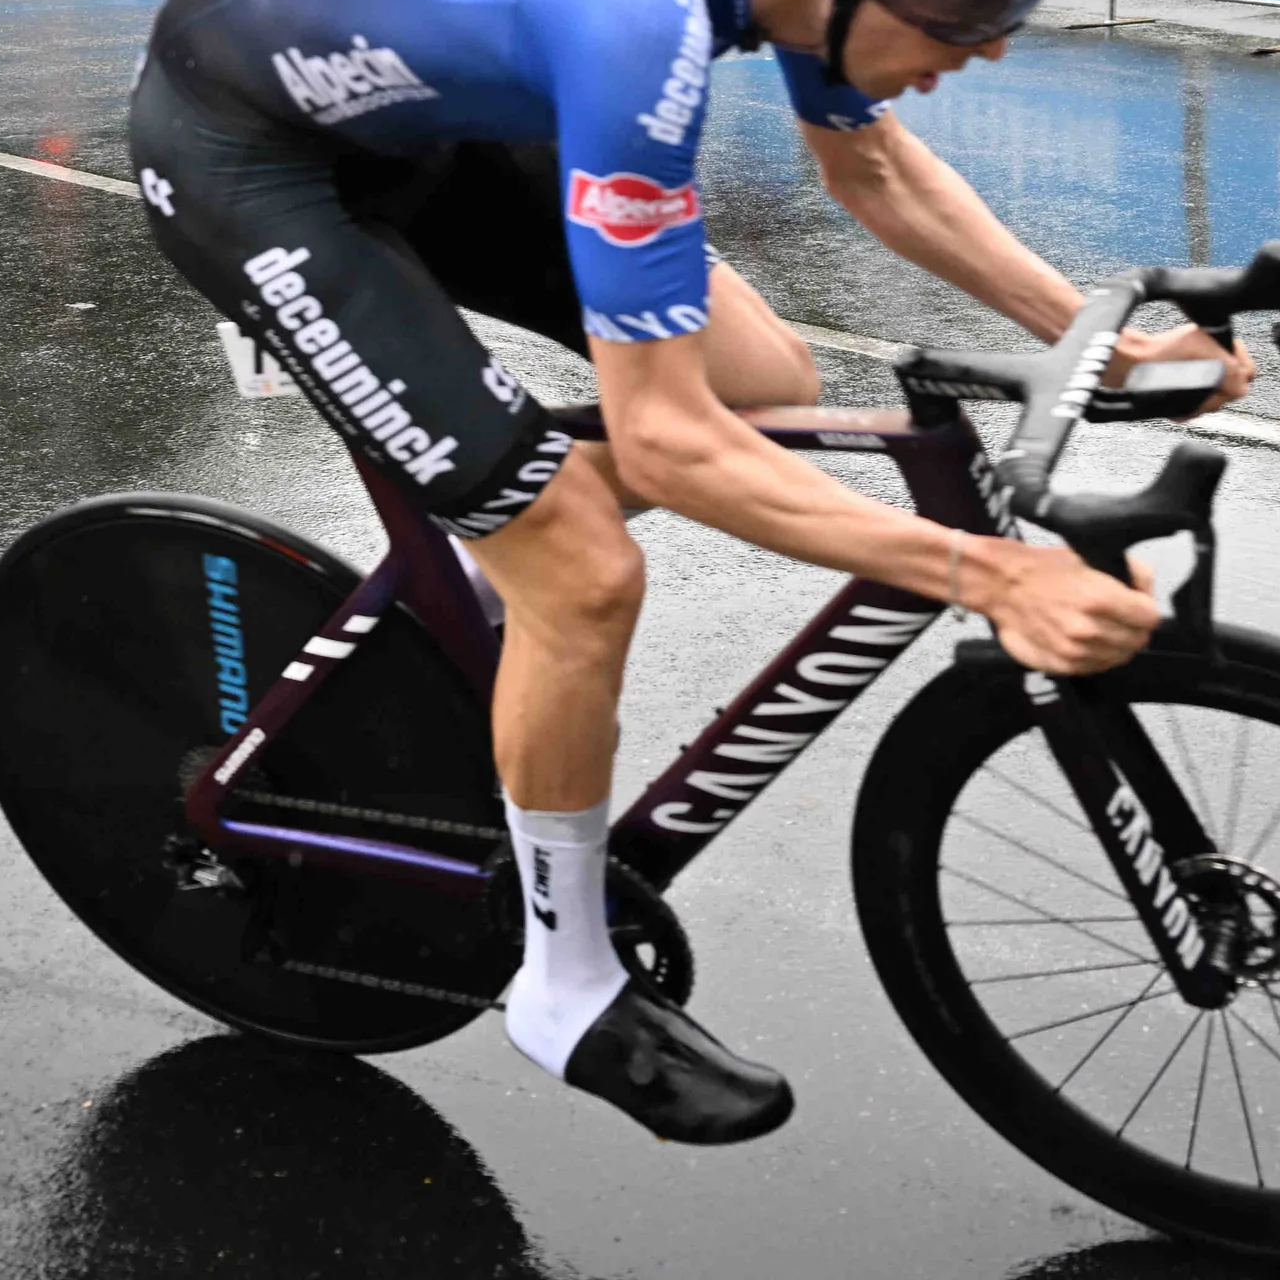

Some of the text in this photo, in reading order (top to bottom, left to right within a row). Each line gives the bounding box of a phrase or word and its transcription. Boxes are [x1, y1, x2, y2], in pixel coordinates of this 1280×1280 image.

[272, 34, 423, 112] Alpecin
[242, 246, 458, 485] deceuninck
[202, 553, 249, 735] SHIMANO
[651, 605, 938, 834] CANYON
[1106, 774, 1206, 971] CANYON
